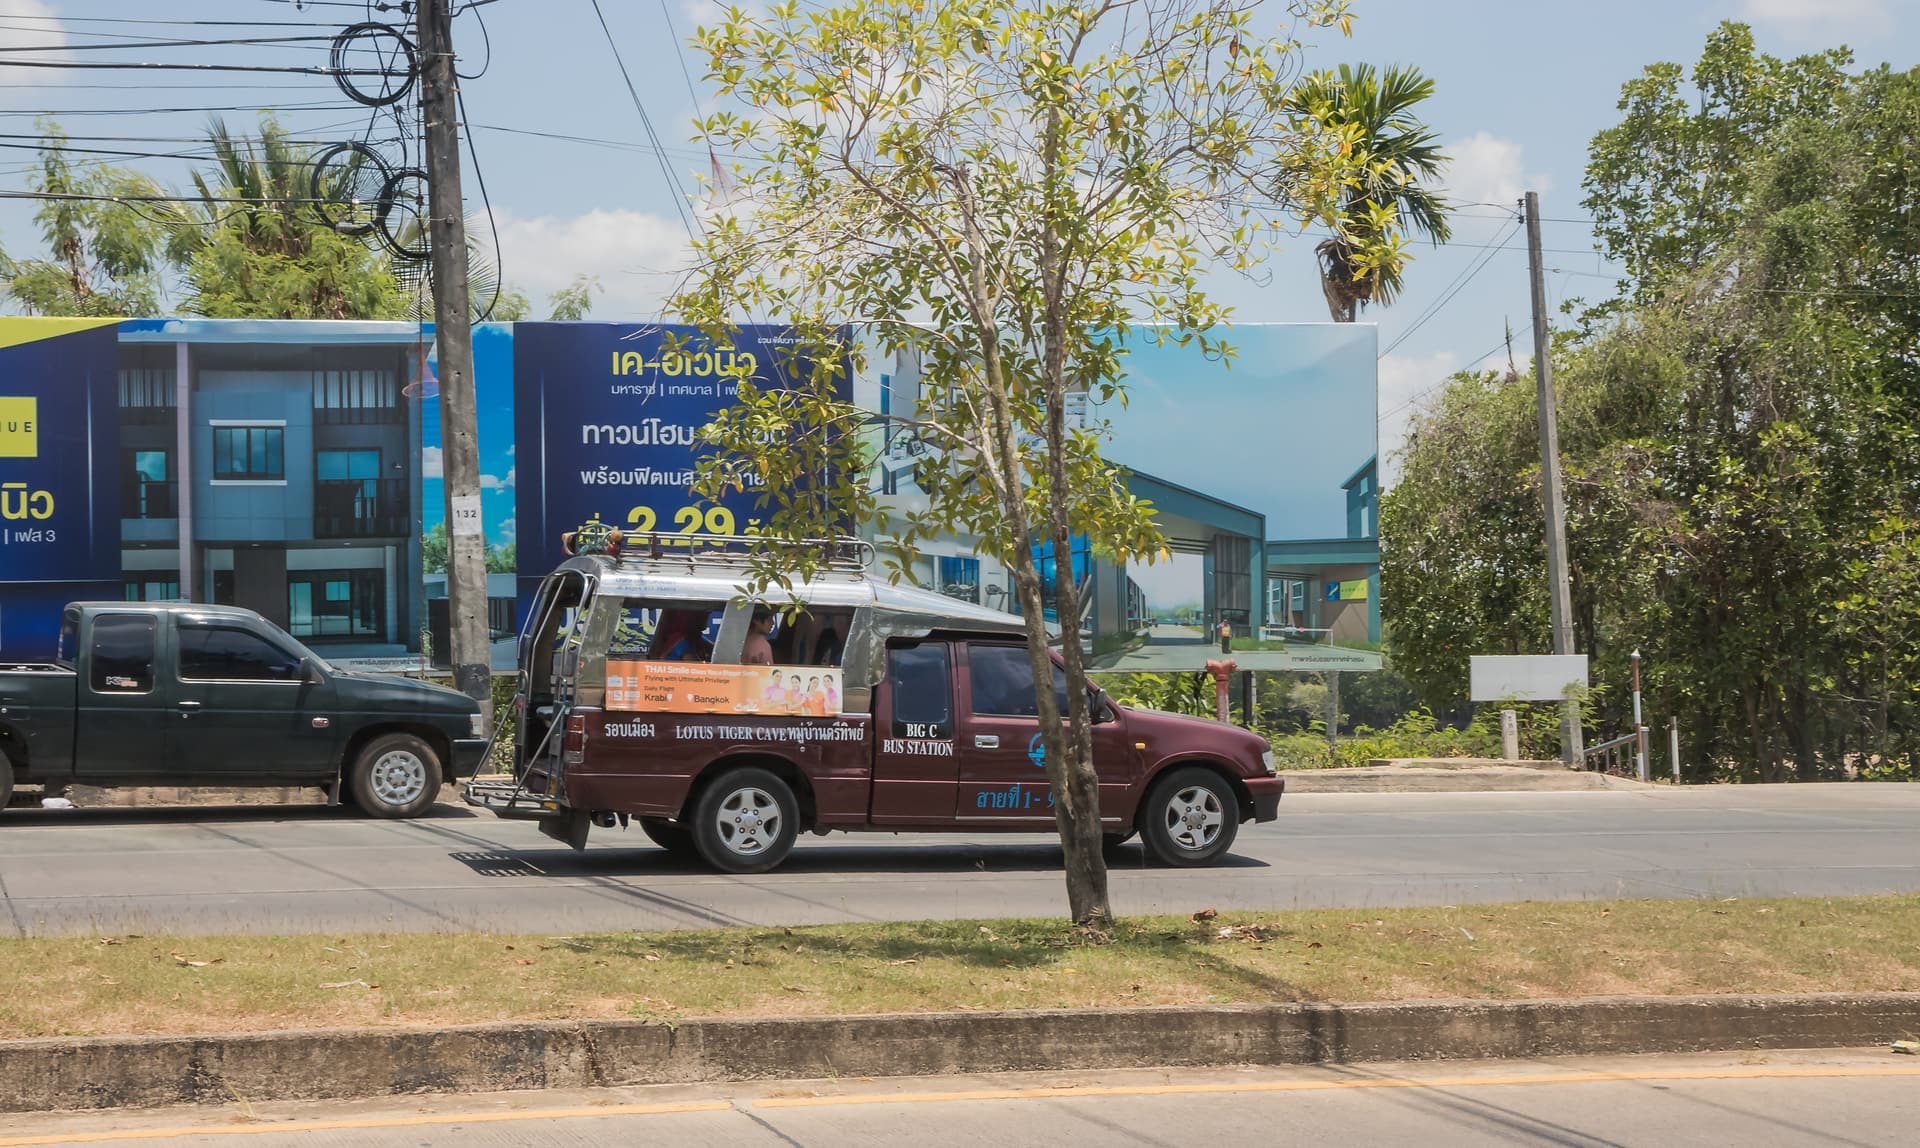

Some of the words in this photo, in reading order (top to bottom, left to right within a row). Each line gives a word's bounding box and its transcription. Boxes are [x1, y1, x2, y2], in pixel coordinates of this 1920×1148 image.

[668, 383, 712, 396] เทศบาล
[582, 418, 694, 445] ทาวน์โฮม
[456, 510, 477, 518] 132
[627, 505, 735, 547] 2.29
[15, 528, 42, 542] เฟส
[45, 529, 56, 543] 3
[644, 694, 667, 702] Krabi
[694, 695, 730, 704] Bangkok
[604, 718, 655, 737] รอบเมือง
[675, 725, 713, 739] LOTUS
[718, 726, 753, 740] TIGER
[756, 727, 787, 741] CAVE
[906, 723, 926, 738] BIG
[929, 724, 937, 738] C
[883, 739, 904, 754] BUS
[906, 740, 953, 756] STATION
[976, 782, 1020, 808] สายที่
